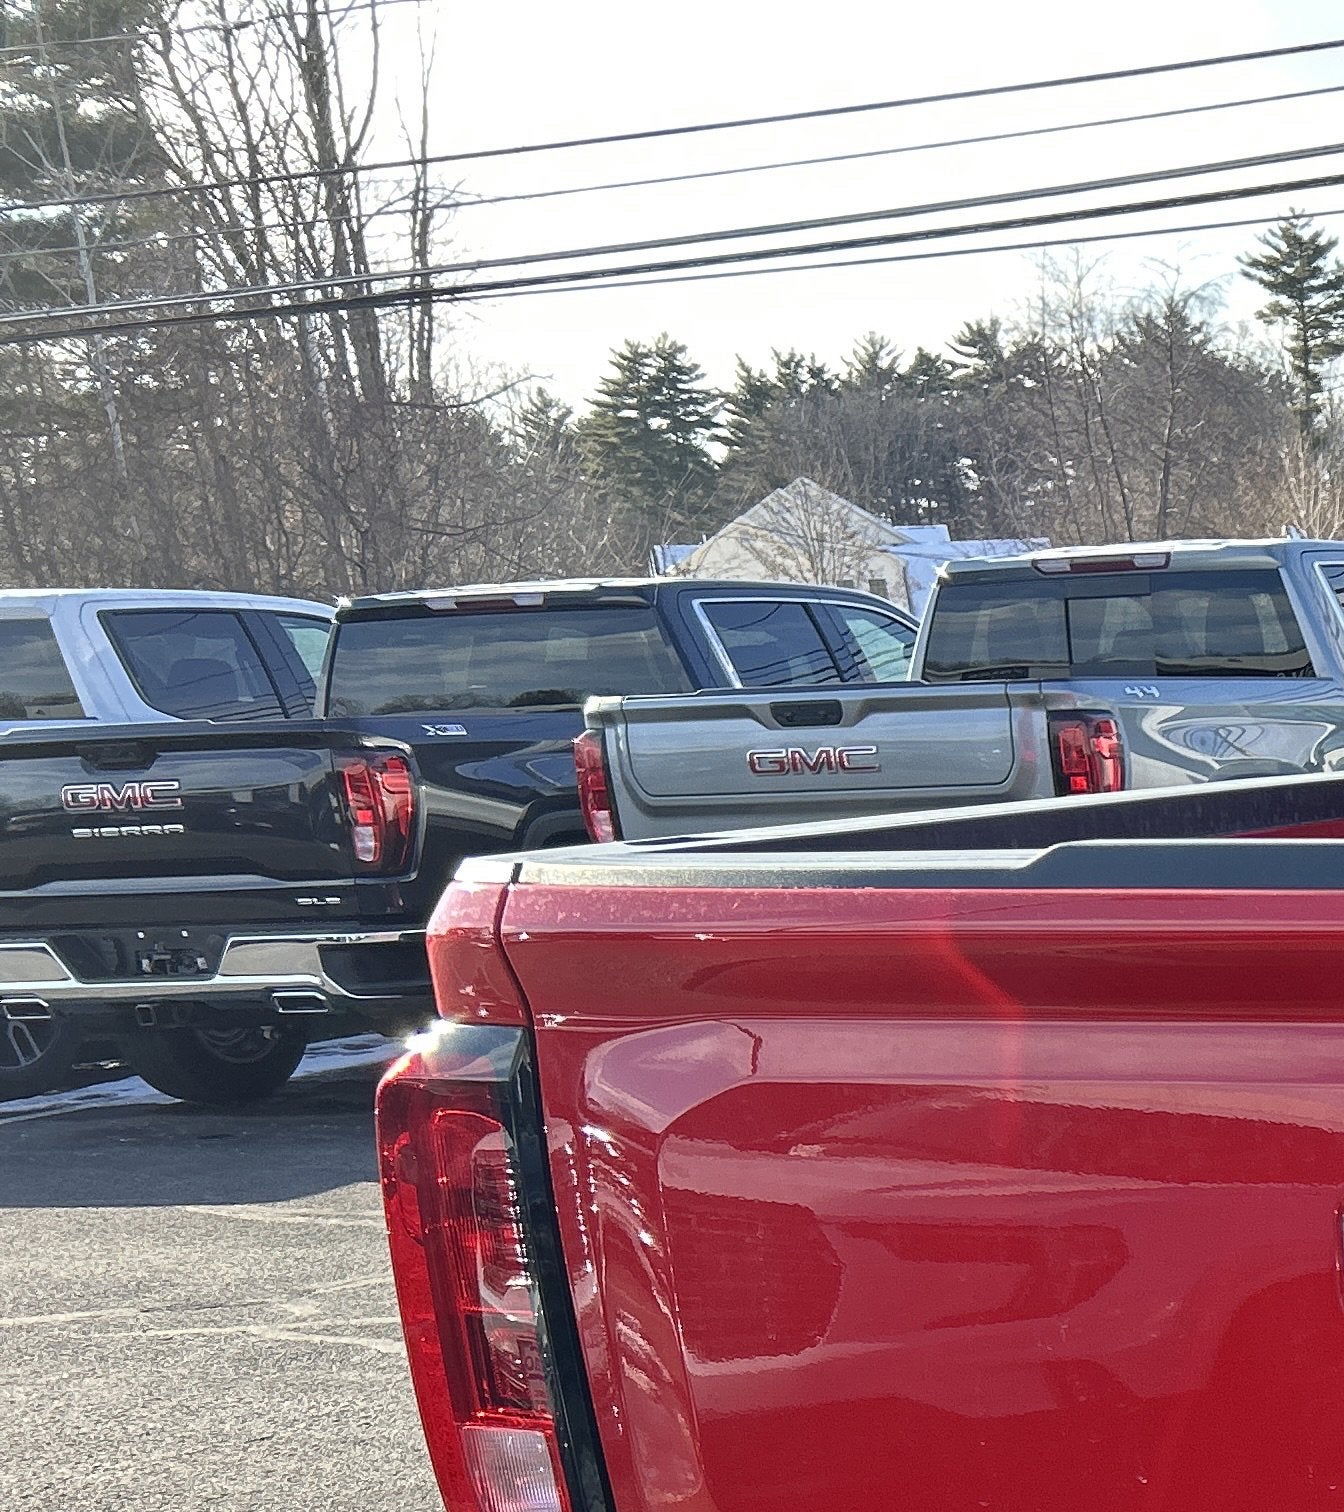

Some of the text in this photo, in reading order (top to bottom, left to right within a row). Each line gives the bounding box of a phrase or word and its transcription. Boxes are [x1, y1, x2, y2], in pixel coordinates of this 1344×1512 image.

[746, 745, 881, 777] GMC
[61, 781, 184, 813] GMC
[71, 824, 185, 838] SIERRA
